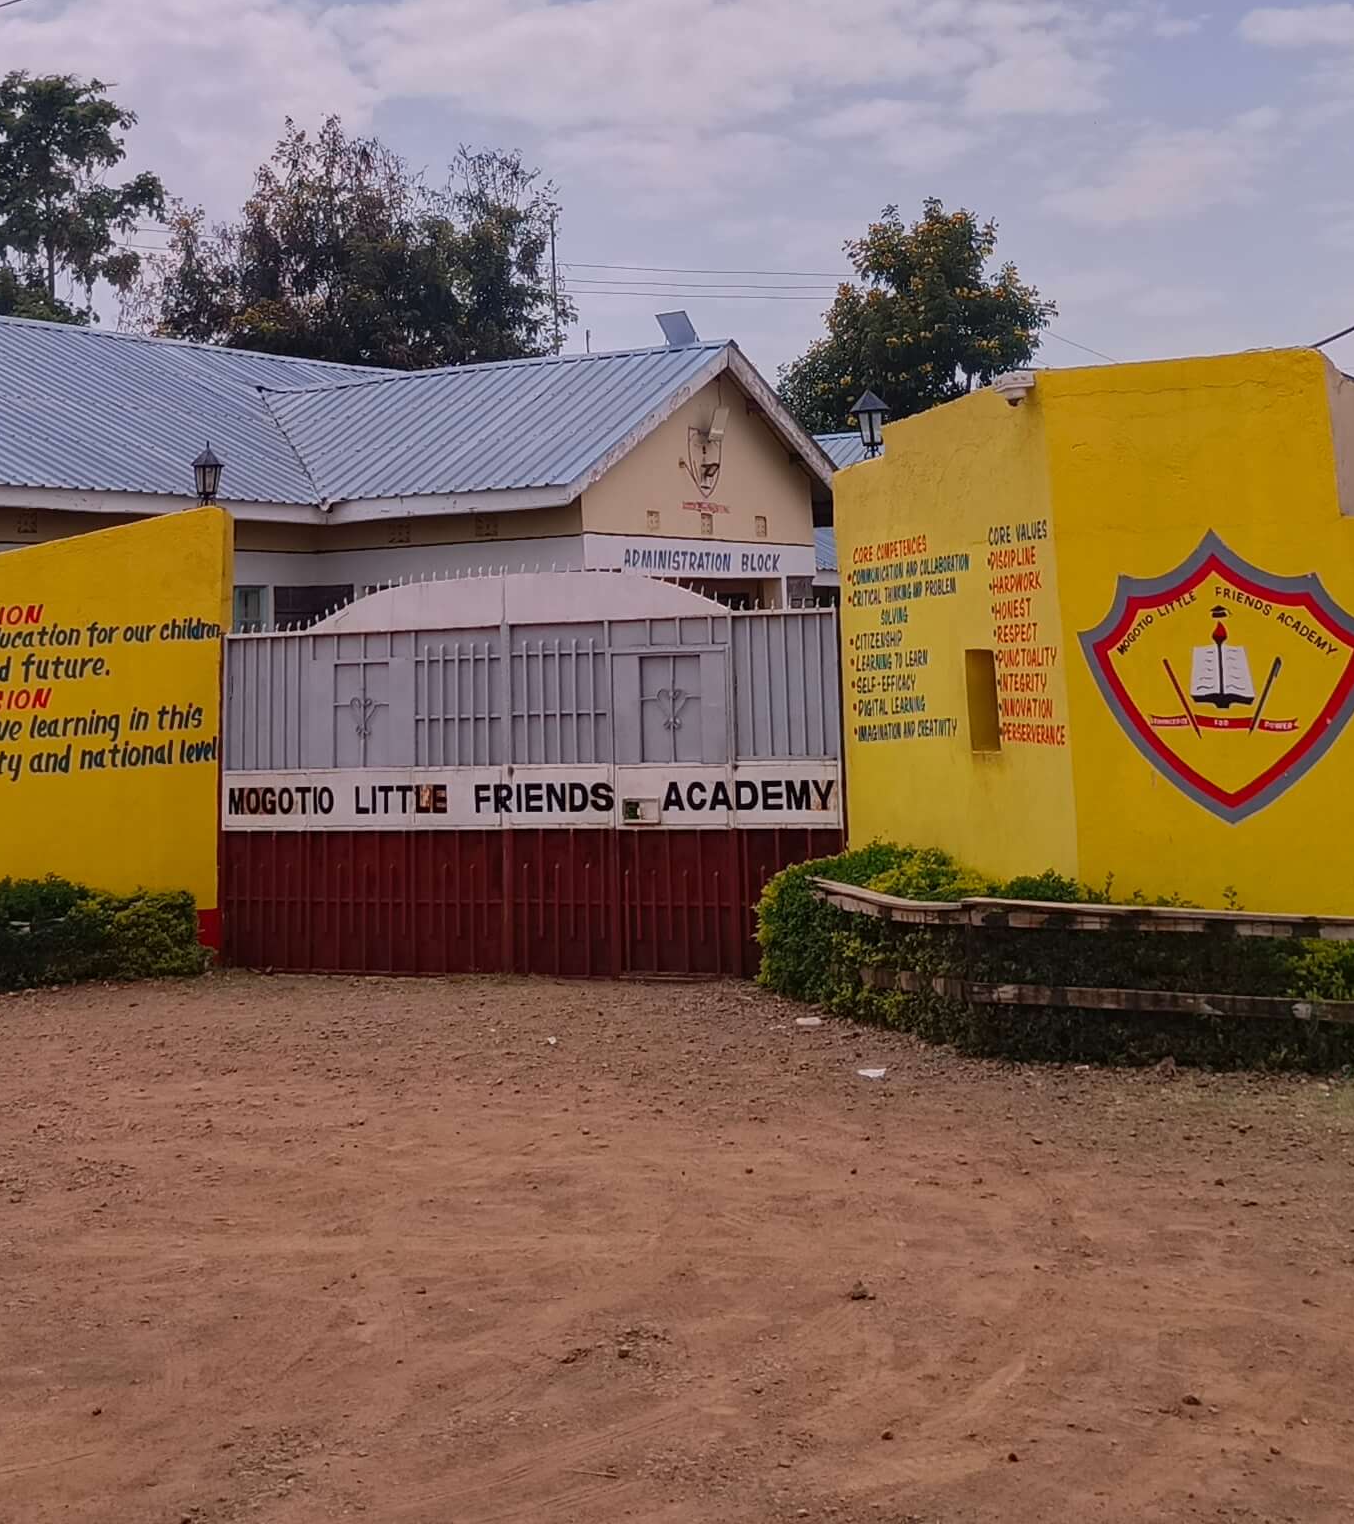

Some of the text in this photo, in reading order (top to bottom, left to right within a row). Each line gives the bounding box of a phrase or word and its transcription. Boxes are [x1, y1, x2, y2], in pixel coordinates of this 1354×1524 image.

[988, 519, 1047, 545] CORE VALUES
[624, 549, 781, 573] ADMINISTRATION BLOCK
[852, 534, 927, 564] CORE COMPETENCIES
[991, 546, 1036, 570] DISCIPLINE
[852, 553, 970, 586] COMMUNICATION AND COLLABORATION
[852, 588, 882, 607] CRITICAL
[884, 582, 911, 603] THINKING
[925, 576, 956, 597] PROBLEM
[993, 570, 1042, 596] HARDWORK
[880, 606, 908, 625] SOLVING
[995, 597, 1031, 620] HONEST
[1117, 586, 1338, 656] MOGOTIO LITTLE FRIENDS ACADEMY
[87, 621, 120, 648] for
[123, 624, 157, 643] our
[855, 630, 902, 650] CITIZENSHIP
[997, 623, 1037, 644] RESPECT
[21, 653, 110, 683] future.
[856, 649, 928, 672] LEARNING TO LEARN
[856, 674, 916, 693] SELF-EFFICACY
[1000, 673, 1047, 692] INTEGRITY
[858, 695, 926, 717] DIGITAL LEARNING
[1002, 698, 1053, 718] INNOVATION
[29, 709, 120, 742] learning
[129, 707, 149, 731] in
[157, 702, 203, 730] this
[858, 717, 957, 742] IMAGINATION AND CREATIVITY
[29, 743, 72, 774] and
[79, 739, 174, 770] national
[180, 736, 217, 764] level
[228, 778, 836, 817] MOGOTIO LITTLE FRIENDS ACADEMY
